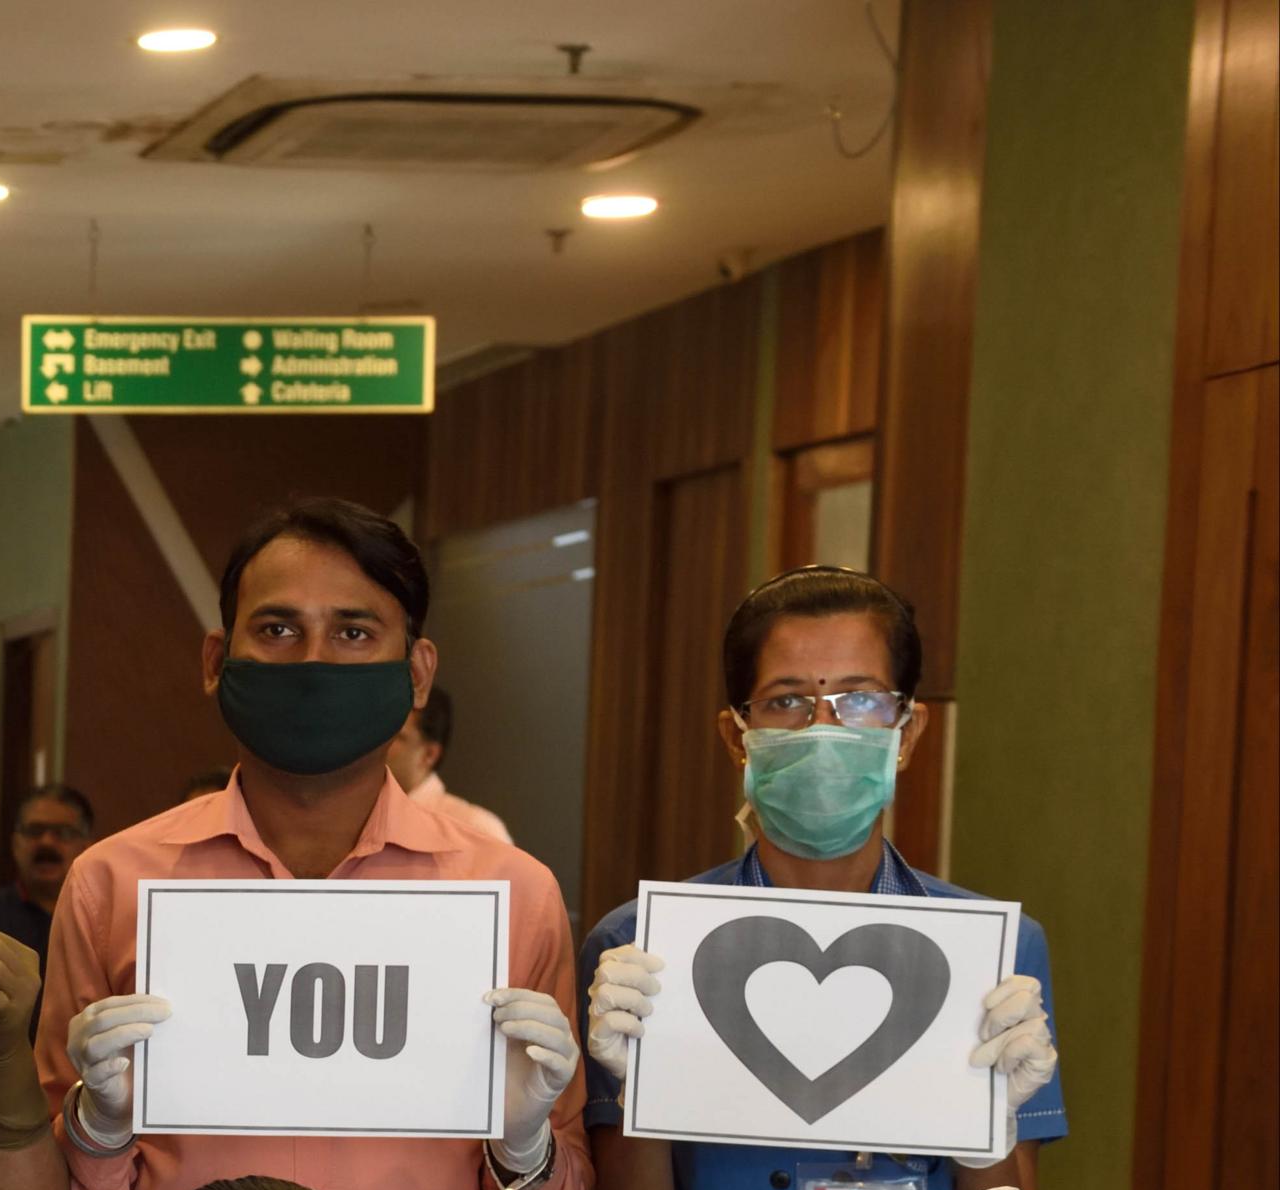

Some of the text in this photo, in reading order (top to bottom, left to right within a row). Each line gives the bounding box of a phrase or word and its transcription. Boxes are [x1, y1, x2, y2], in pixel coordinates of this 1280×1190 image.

[83, 328, 217, 352] Emergency Exit
[272, 329, 395, 353] Waiting Room
[83, 355, 171, 376] Basement
[271, 354, 398, 376] Administration
[83, 381, 114, 402] Lift
[271, 382, 351, 402] Cafeteria
[234, 963, 409, 1059] YOU
